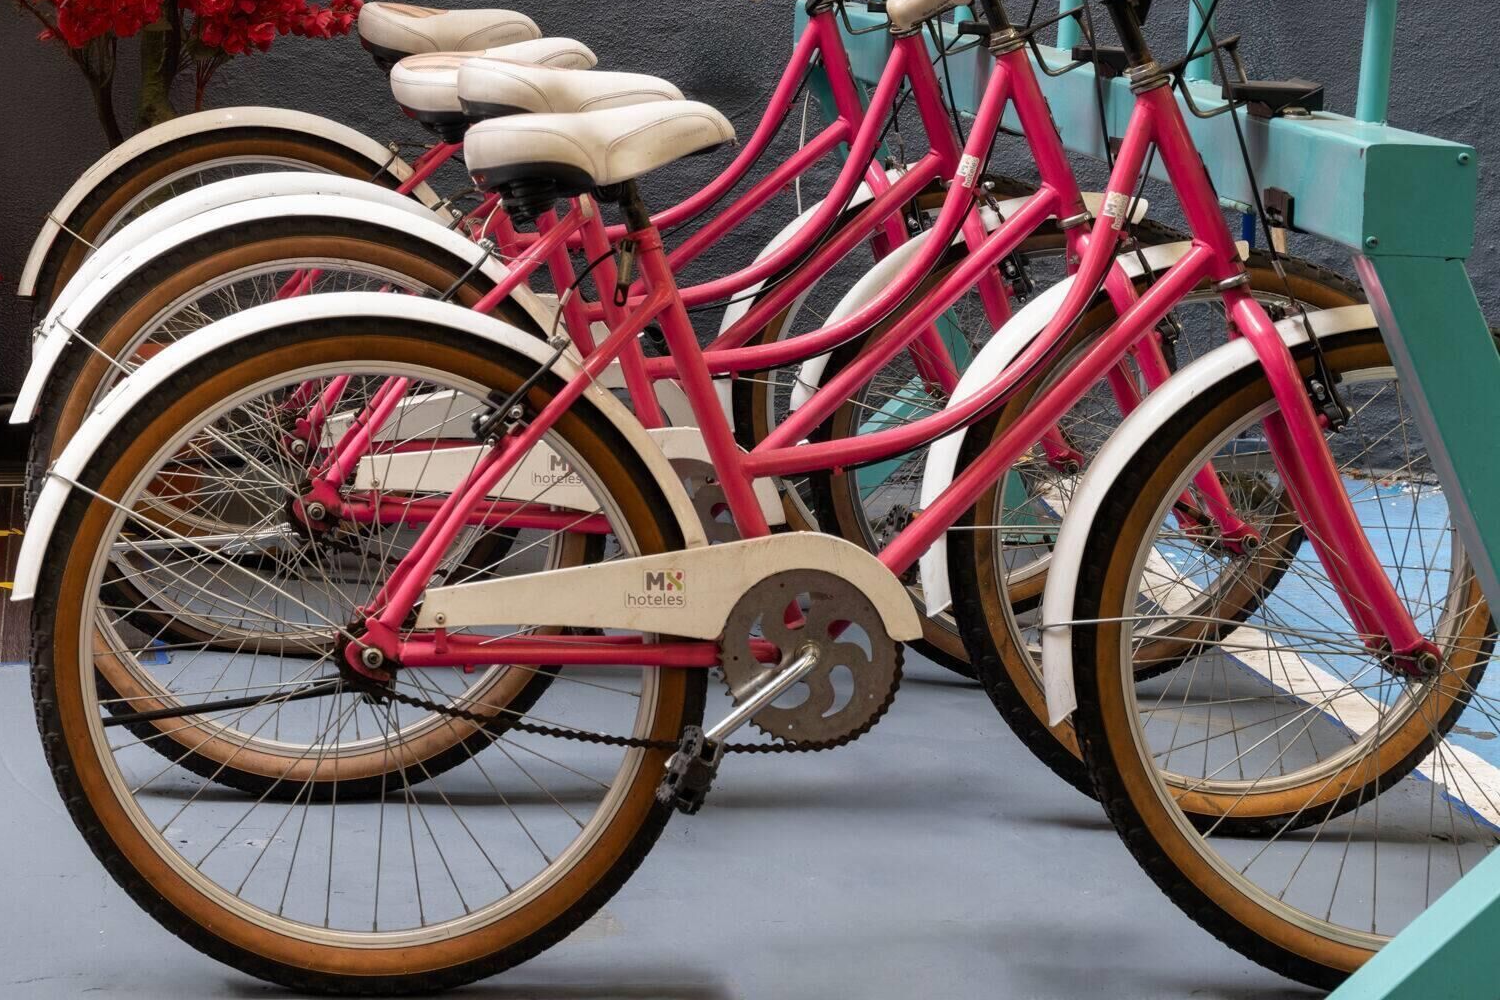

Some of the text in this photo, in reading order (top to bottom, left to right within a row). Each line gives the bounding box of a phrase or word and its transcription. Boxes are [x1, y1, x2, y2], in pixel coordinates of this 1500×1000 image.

[550, 455, 570, 471] M
[534, 472, 582, 484] hoteles
[646, 572, 683, 590] MX
[627, 593, 684, 606] hoteles
